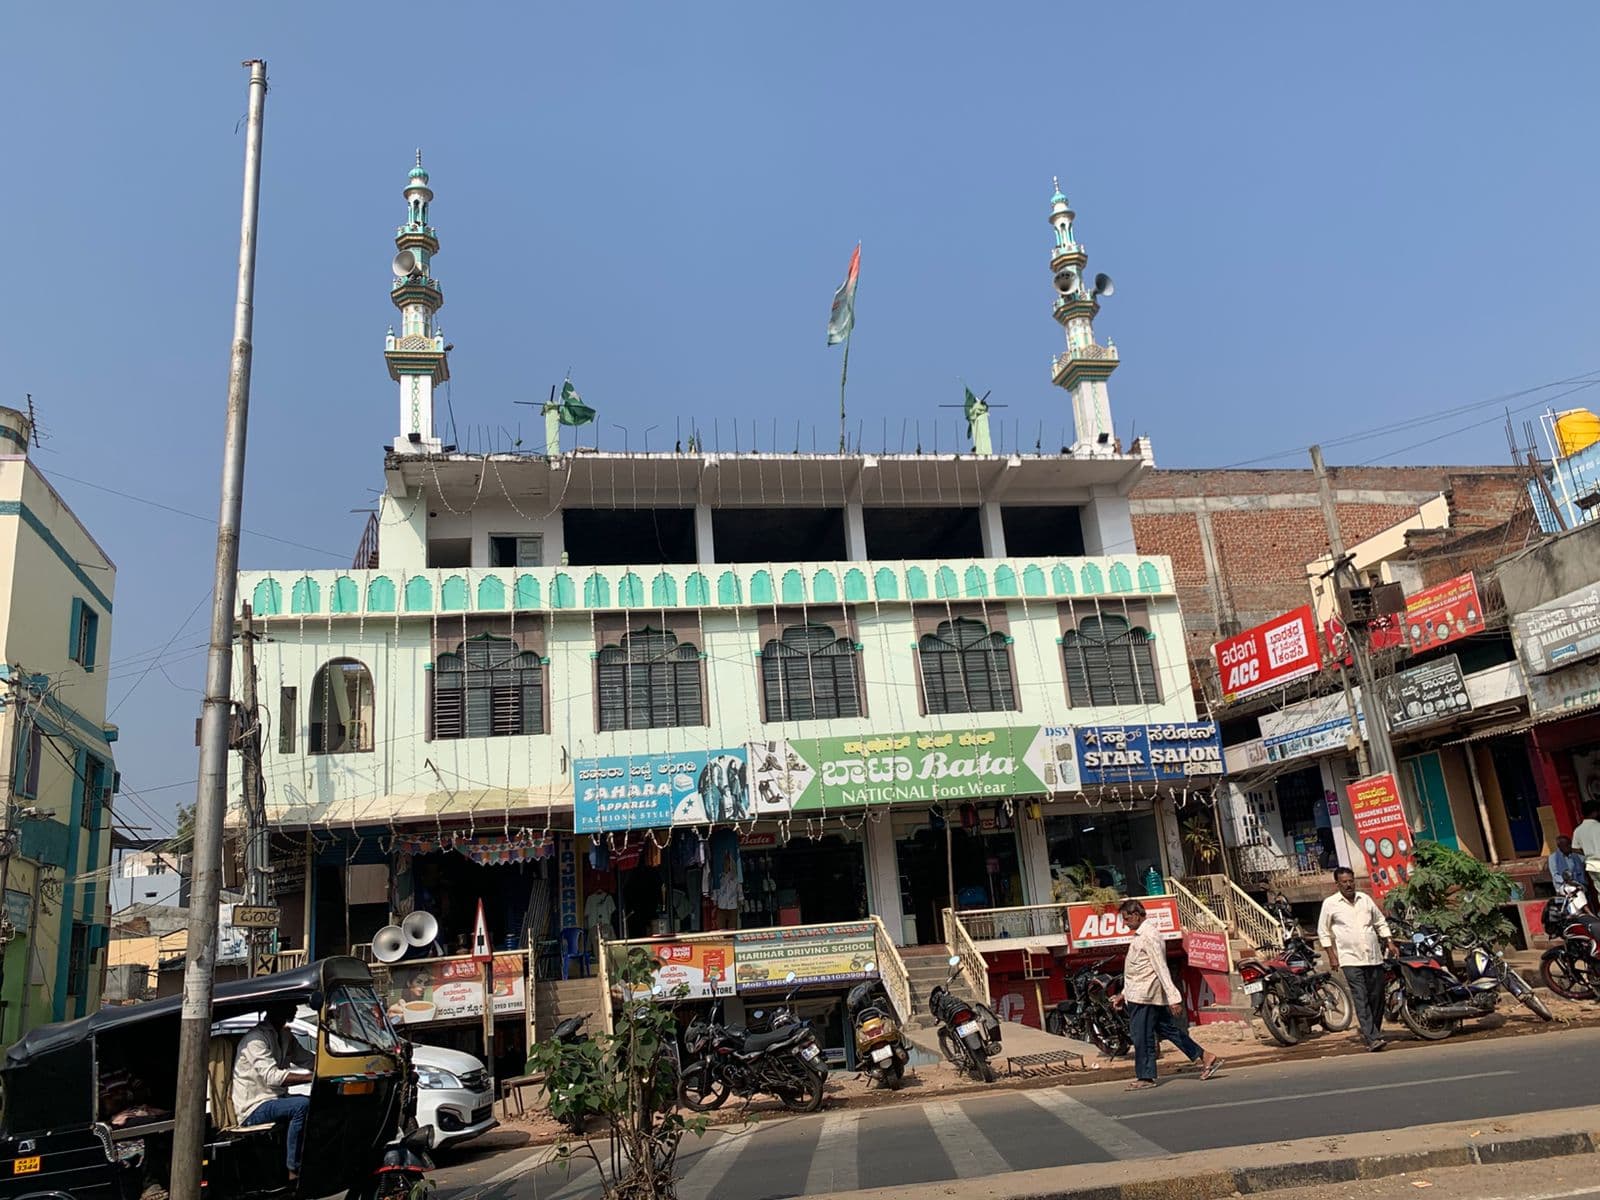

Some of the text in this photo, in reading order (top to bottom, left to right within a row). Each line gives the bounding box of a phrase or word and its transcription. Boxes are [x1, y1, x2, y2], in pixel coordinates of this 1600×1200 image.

[1221, 633, 1257, 667] adani
[1228, 658, 1260, 691] ACC
[1045, 726, 1070, 737] DSY
[1084, 746, 1221, 767] STAR SALON
[657, 761, 698, 775] ಅಂಗಡಿ
[822, 751, 1020, 787] ಬಾಟಾ Bata
[583, 782, 672, 802] SAHARA
[842, 781, 1007, 803] NATIONAL Foot Wear
[598, 799, 658, 812] APPARELS
[582, 813, 628, 824] FASHION
[639, 811, 671, 820] STYLE
[737, 949, 785, 961] HARIHAR
[787, 945, 829, 957] DRIVING
[831, 941, 873, 954] SCHOOL
[712, 986, 733, 996] TORE
[742, 981, 765, 990] Mob:
